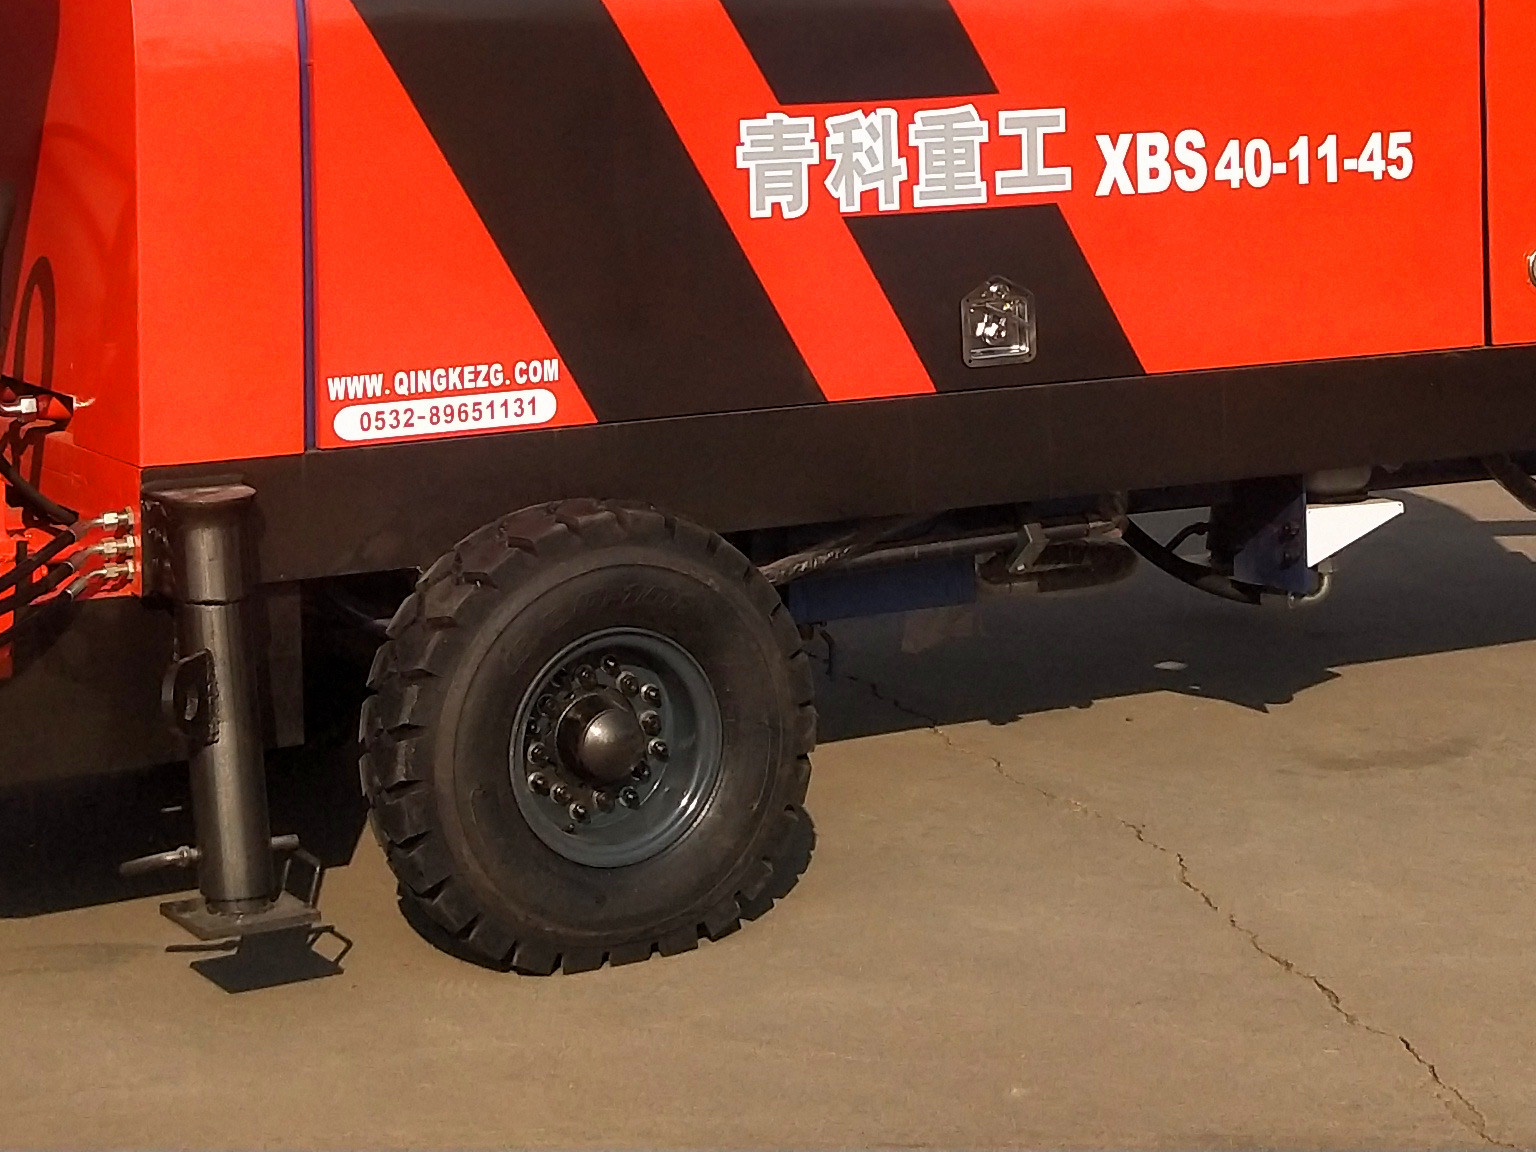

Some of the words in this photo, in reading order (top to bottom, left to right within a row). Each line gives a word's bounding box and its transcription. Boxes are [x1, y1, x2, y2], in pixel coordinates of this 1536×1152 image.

[735, 105, 1073, 220] 青科重工
[359, 395, 537, 432] 0532-89651131
